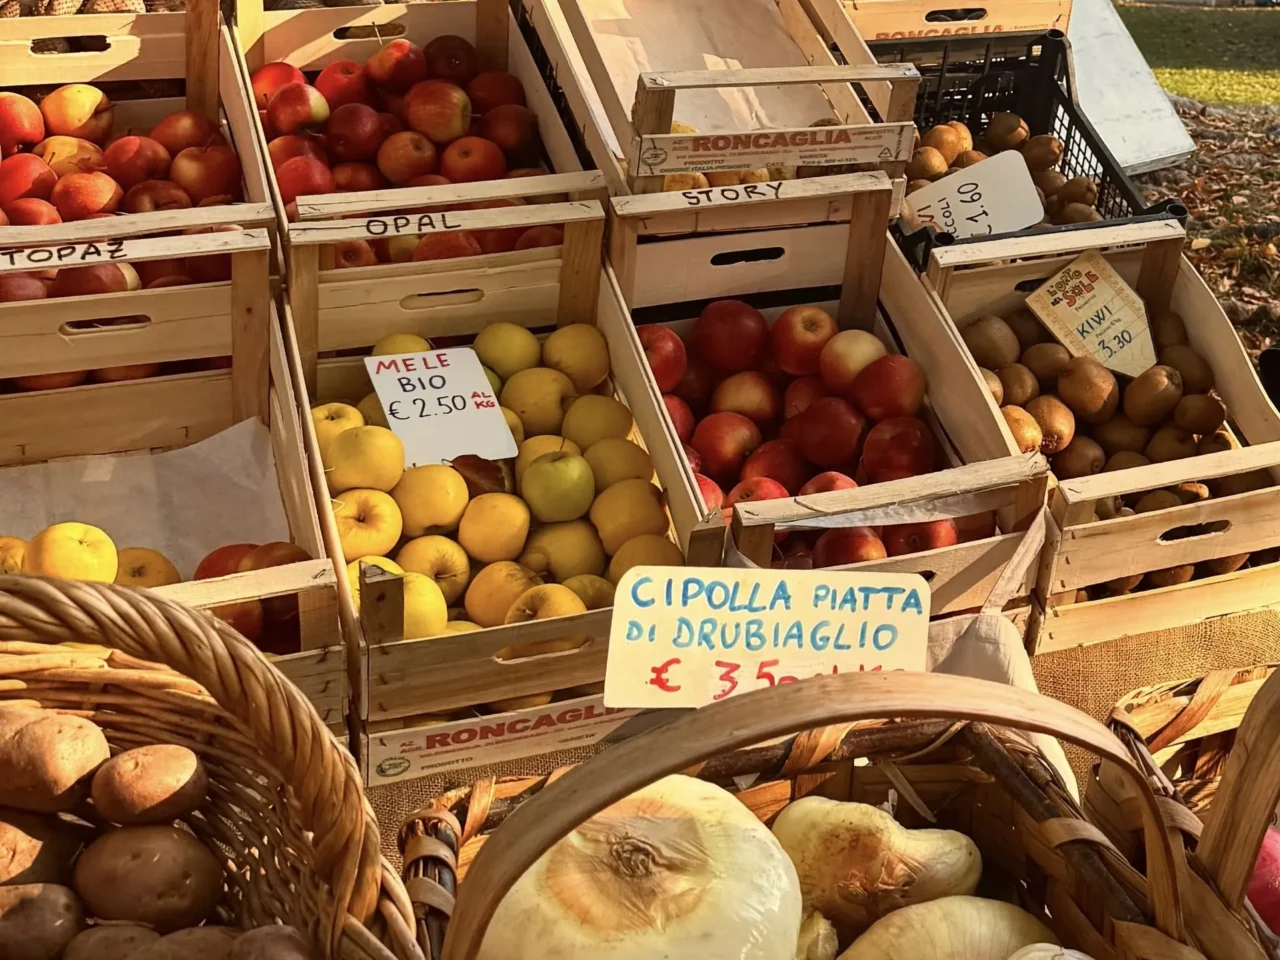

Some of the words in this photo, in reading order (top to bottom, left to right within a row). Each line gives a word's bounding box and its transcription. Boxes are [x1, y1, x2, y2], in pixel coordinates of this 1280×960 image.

[692, 129, 852, 152] RONCAGLIA
[682, 182, 783, 205] STORY
[957, 182, 989, 223] 1.60
[366, 213, 462, 236] OPAL
[0, 241, 127, 266] TOPAZ
[1062, 270, 1099, 308] SOLE
[1076, 305, 1113, 340] KIWI
[1098, 329, 1132, 359] 3.30
[375, 353, 450, 375] MELE
[397, 375, 446, 393] BIO
[471, 391, 492, 399] AL
[388, 400, 410, 420] €
[412, 395, 467, 418] 2.50
[474, 400, 496, 409] KG
[631, 576, 792, 613] CIPOLLA
[813, 584, 923, 615] PIATTA
[625, 619, 656, 642] DI
[672, 616, 898, 652] DRUBIAGLIO
[650, 657, 681, 692] €
[421, 757, 473, 770] PRODOTTO
